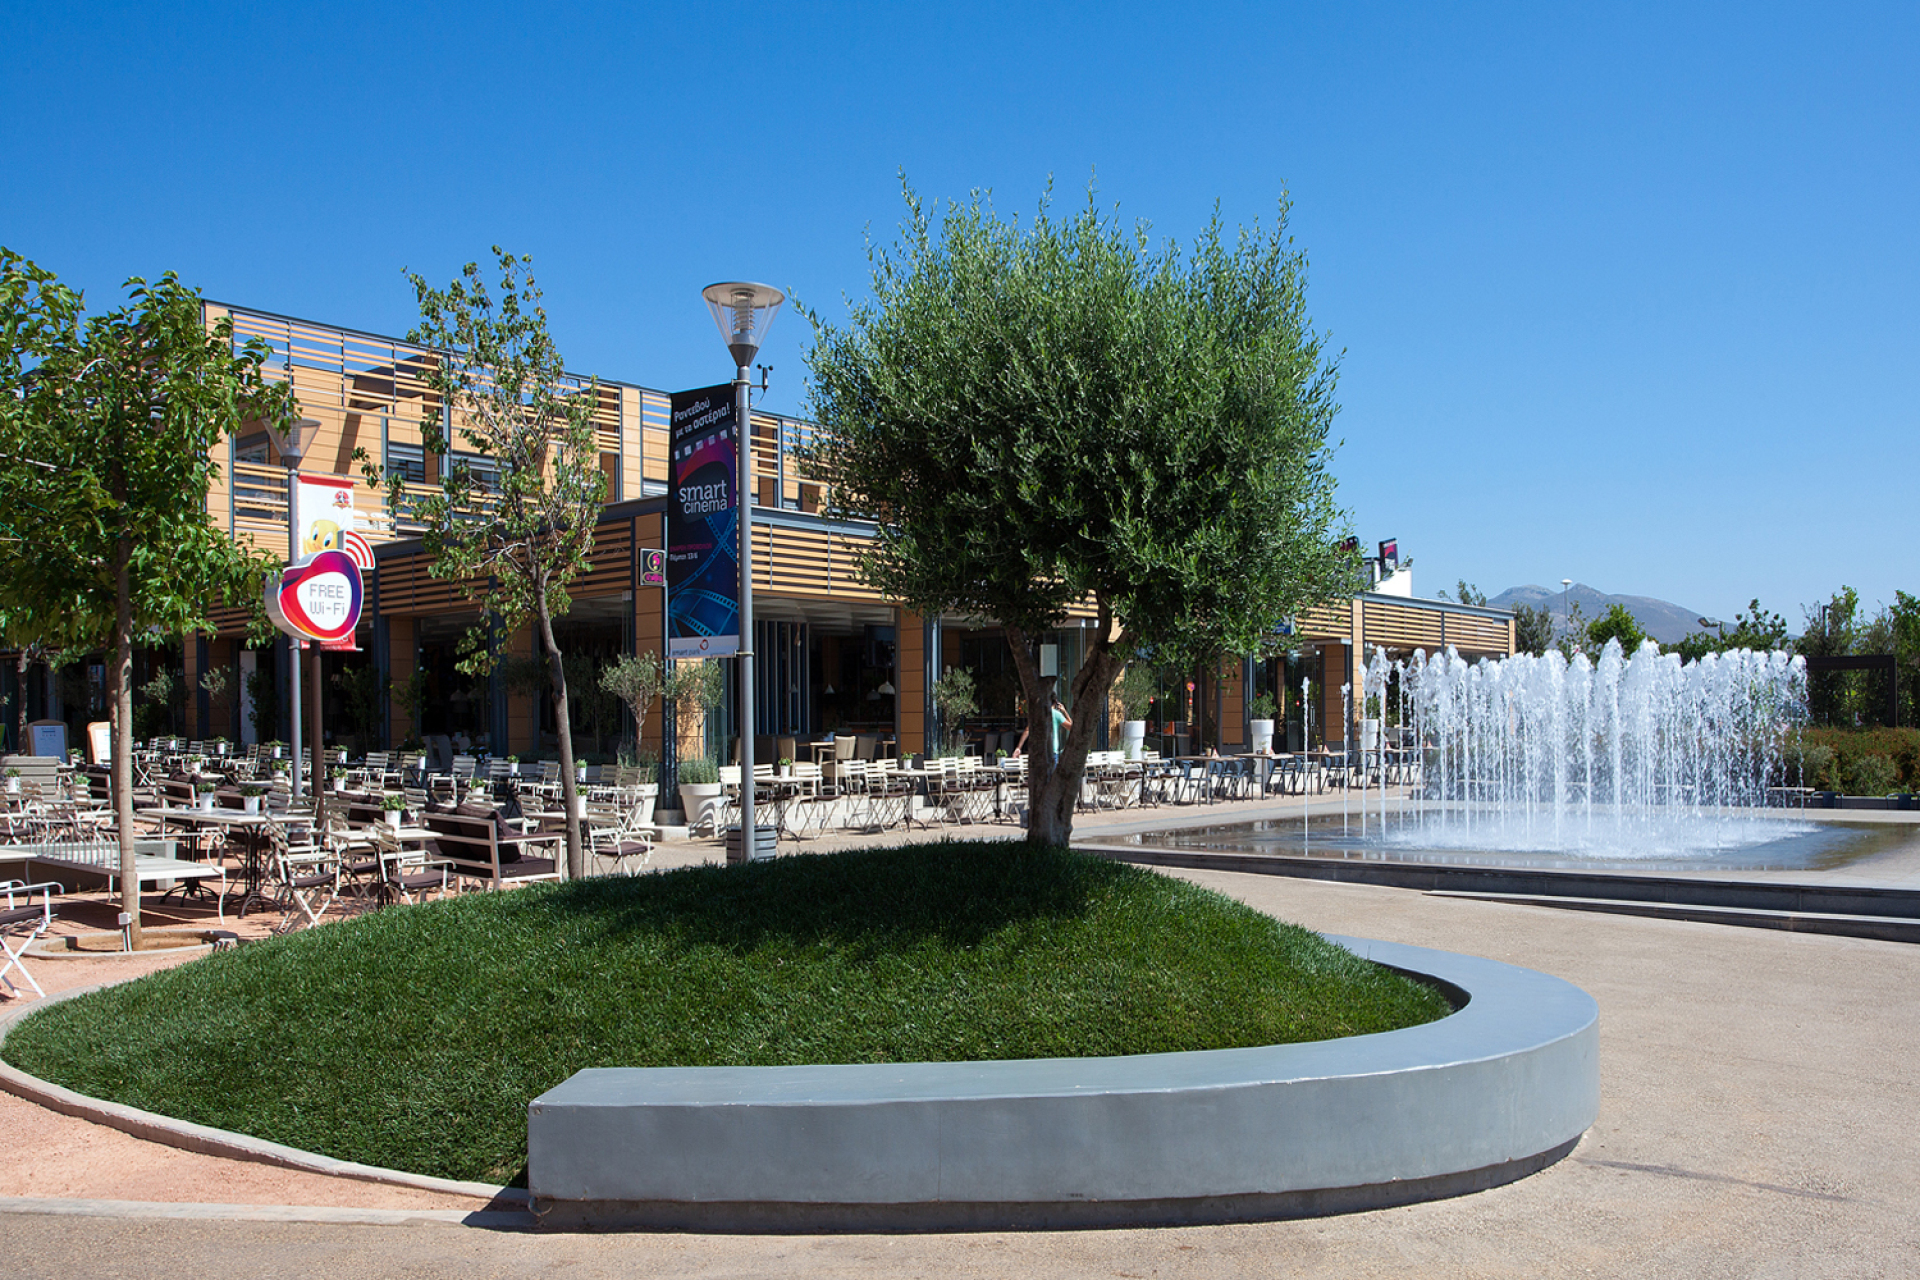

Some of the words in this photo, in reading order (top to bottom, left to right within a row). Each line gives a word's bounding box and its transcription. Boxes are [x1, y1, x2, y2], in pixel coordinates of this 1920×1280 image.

[679, 480, 727, 502] smart
[684, 499, 728, 514] cinema
[310, 584, 344, 598] FREE
[310, 601, 345, 615] Wi-Fi
